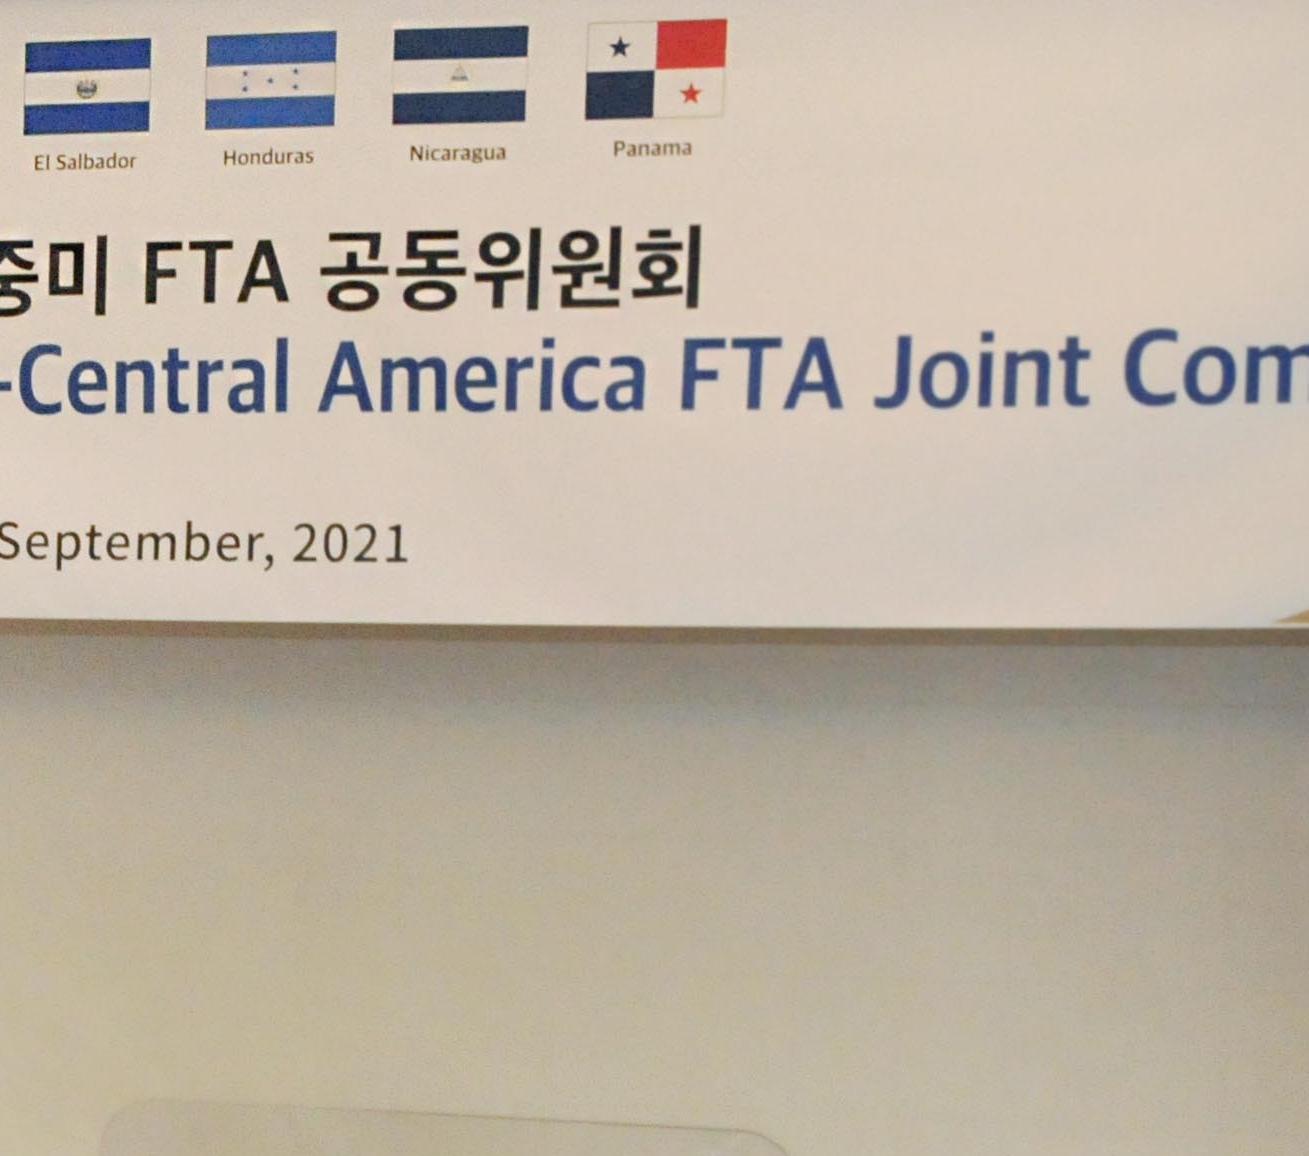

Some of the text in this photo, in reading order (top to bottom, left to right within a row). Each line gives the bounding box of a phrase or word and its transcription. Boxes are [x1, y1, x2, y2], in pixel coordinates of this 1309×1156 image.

[223, 147, 315, 166] Honduras
[409, 144, 507, 166] Nicaragua
[612, 139, 692, 157] Panama
[33, 150, 137, 172] El Salbador
[144, 238, 290, 304] FTA
[319, 223, 702, 313] 공동위원회
[317, 336, 646, 414] America
[680, 335, 844, 412] FTA
[873, 330, 1092, 410] Joint
[292, 522, 409, 564] 2021
